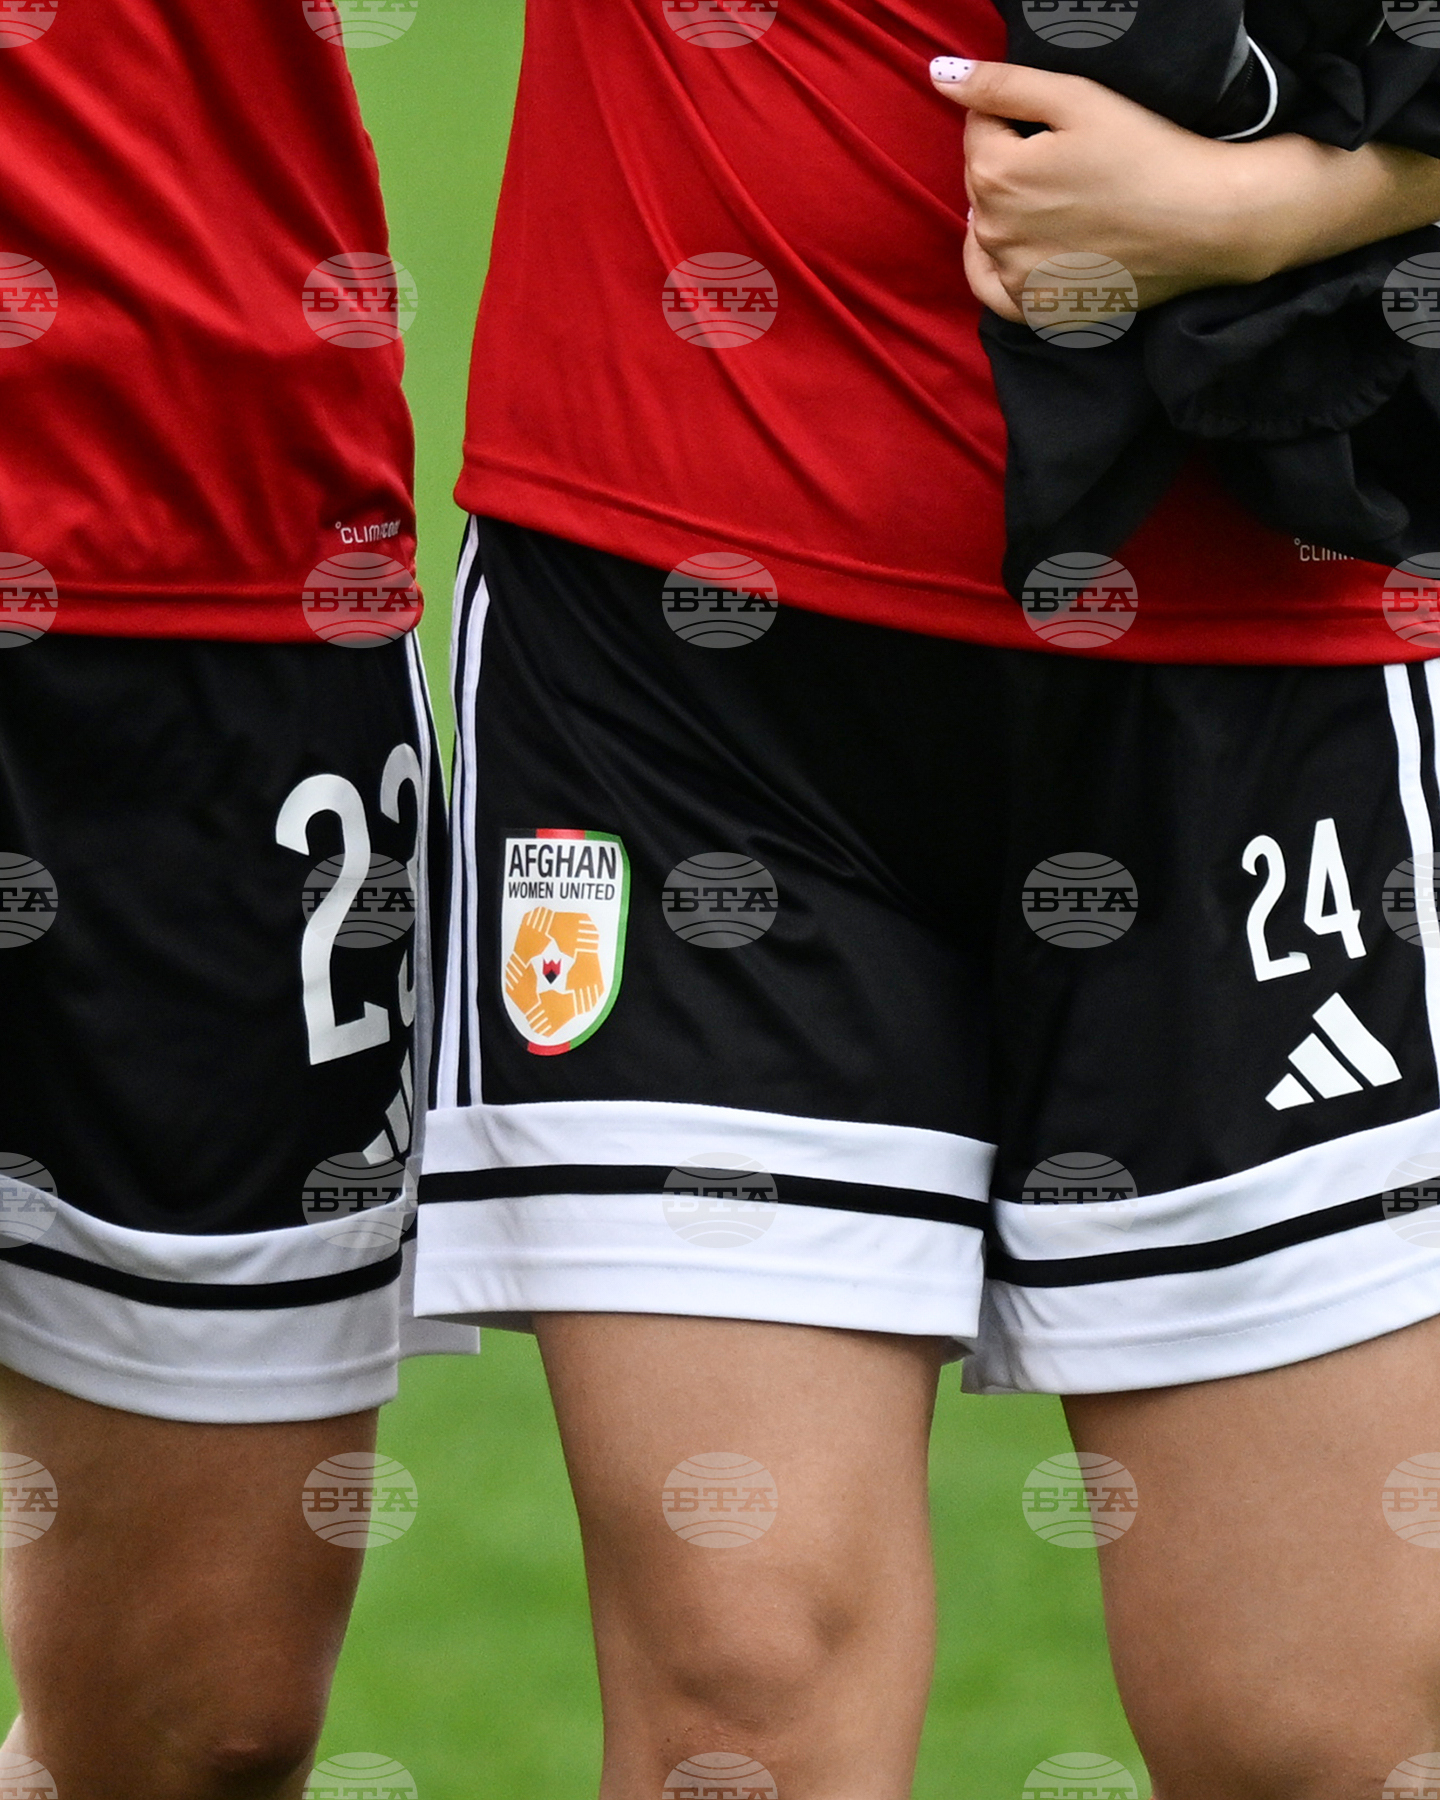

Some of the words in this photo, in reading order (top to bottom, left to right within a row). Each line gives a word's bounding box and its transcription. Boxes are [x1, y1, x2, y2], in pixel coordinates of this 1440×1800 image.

[508, 843, 617, 880] AFGHAN
[508, 881, 554, 899] WOMEN
[560, 882, 616, 901] UNITED
[1242, 817, 1367, 982] 24
